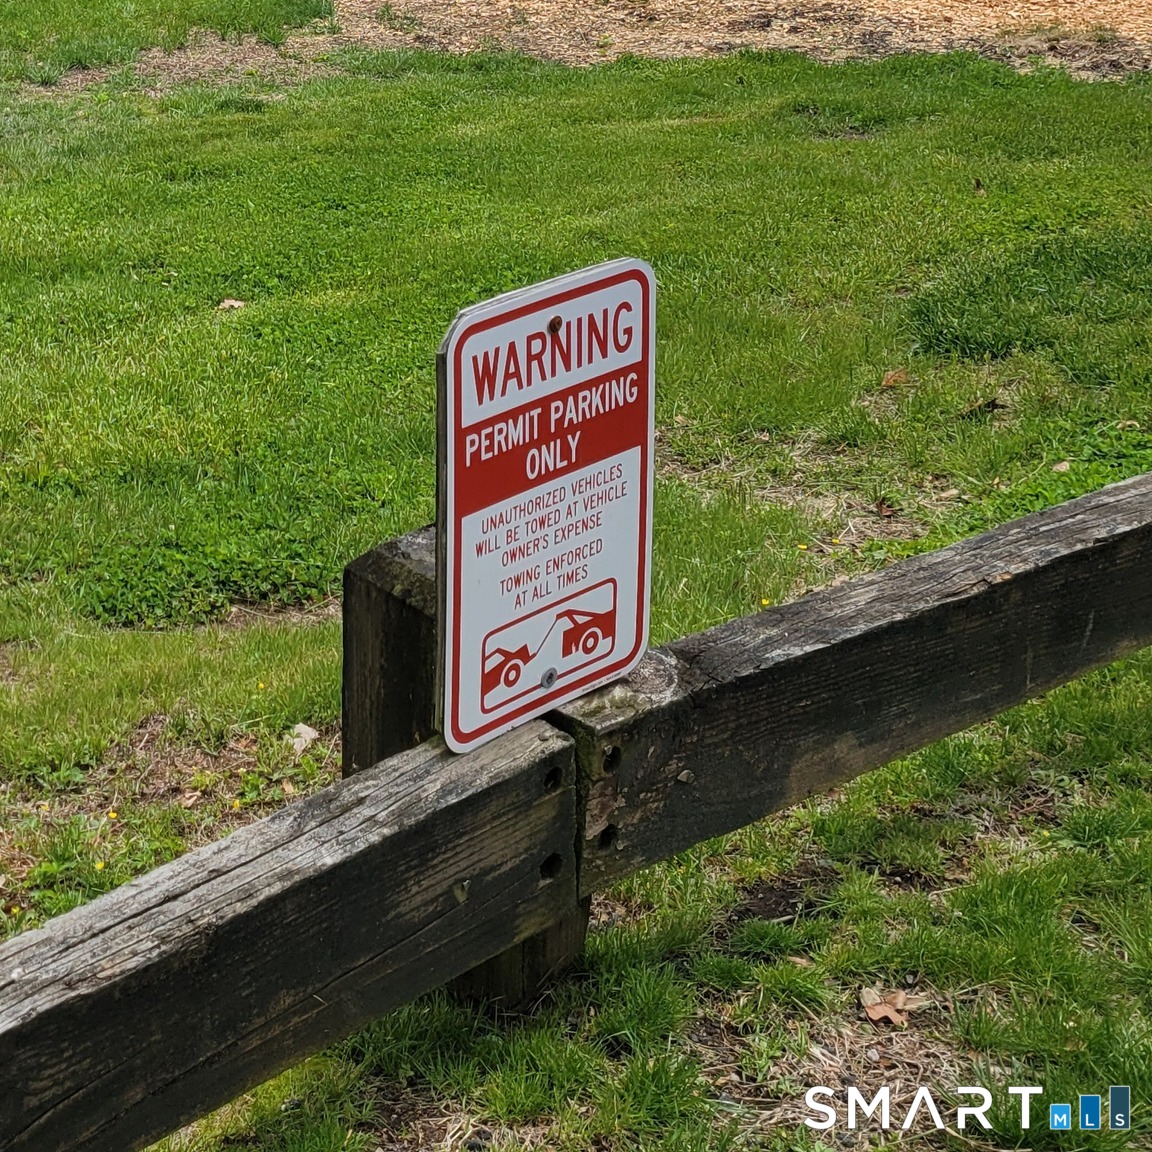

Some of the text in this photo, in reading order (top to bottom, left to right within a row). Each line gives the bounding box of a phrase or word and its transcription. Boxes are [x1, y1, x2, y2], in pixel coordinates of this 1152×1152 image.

[471, 301, 633, 406] WARNING
[465, 372, 638, 468] PERMIT PARKING
[525, 430, 582, 480] ONLY
[475, 480, 628, 559] WILL BE TOWED AT VEHICLE
[481, 463, 623, 535] UNAUTHORIZED VEHICLES
[500, 538, 603, 597] TOWING ENFORCED
[501, 510, 603, 567] OWNER'S EXPENSE
[514, 564, 589, 610] AT ALL TIMES
